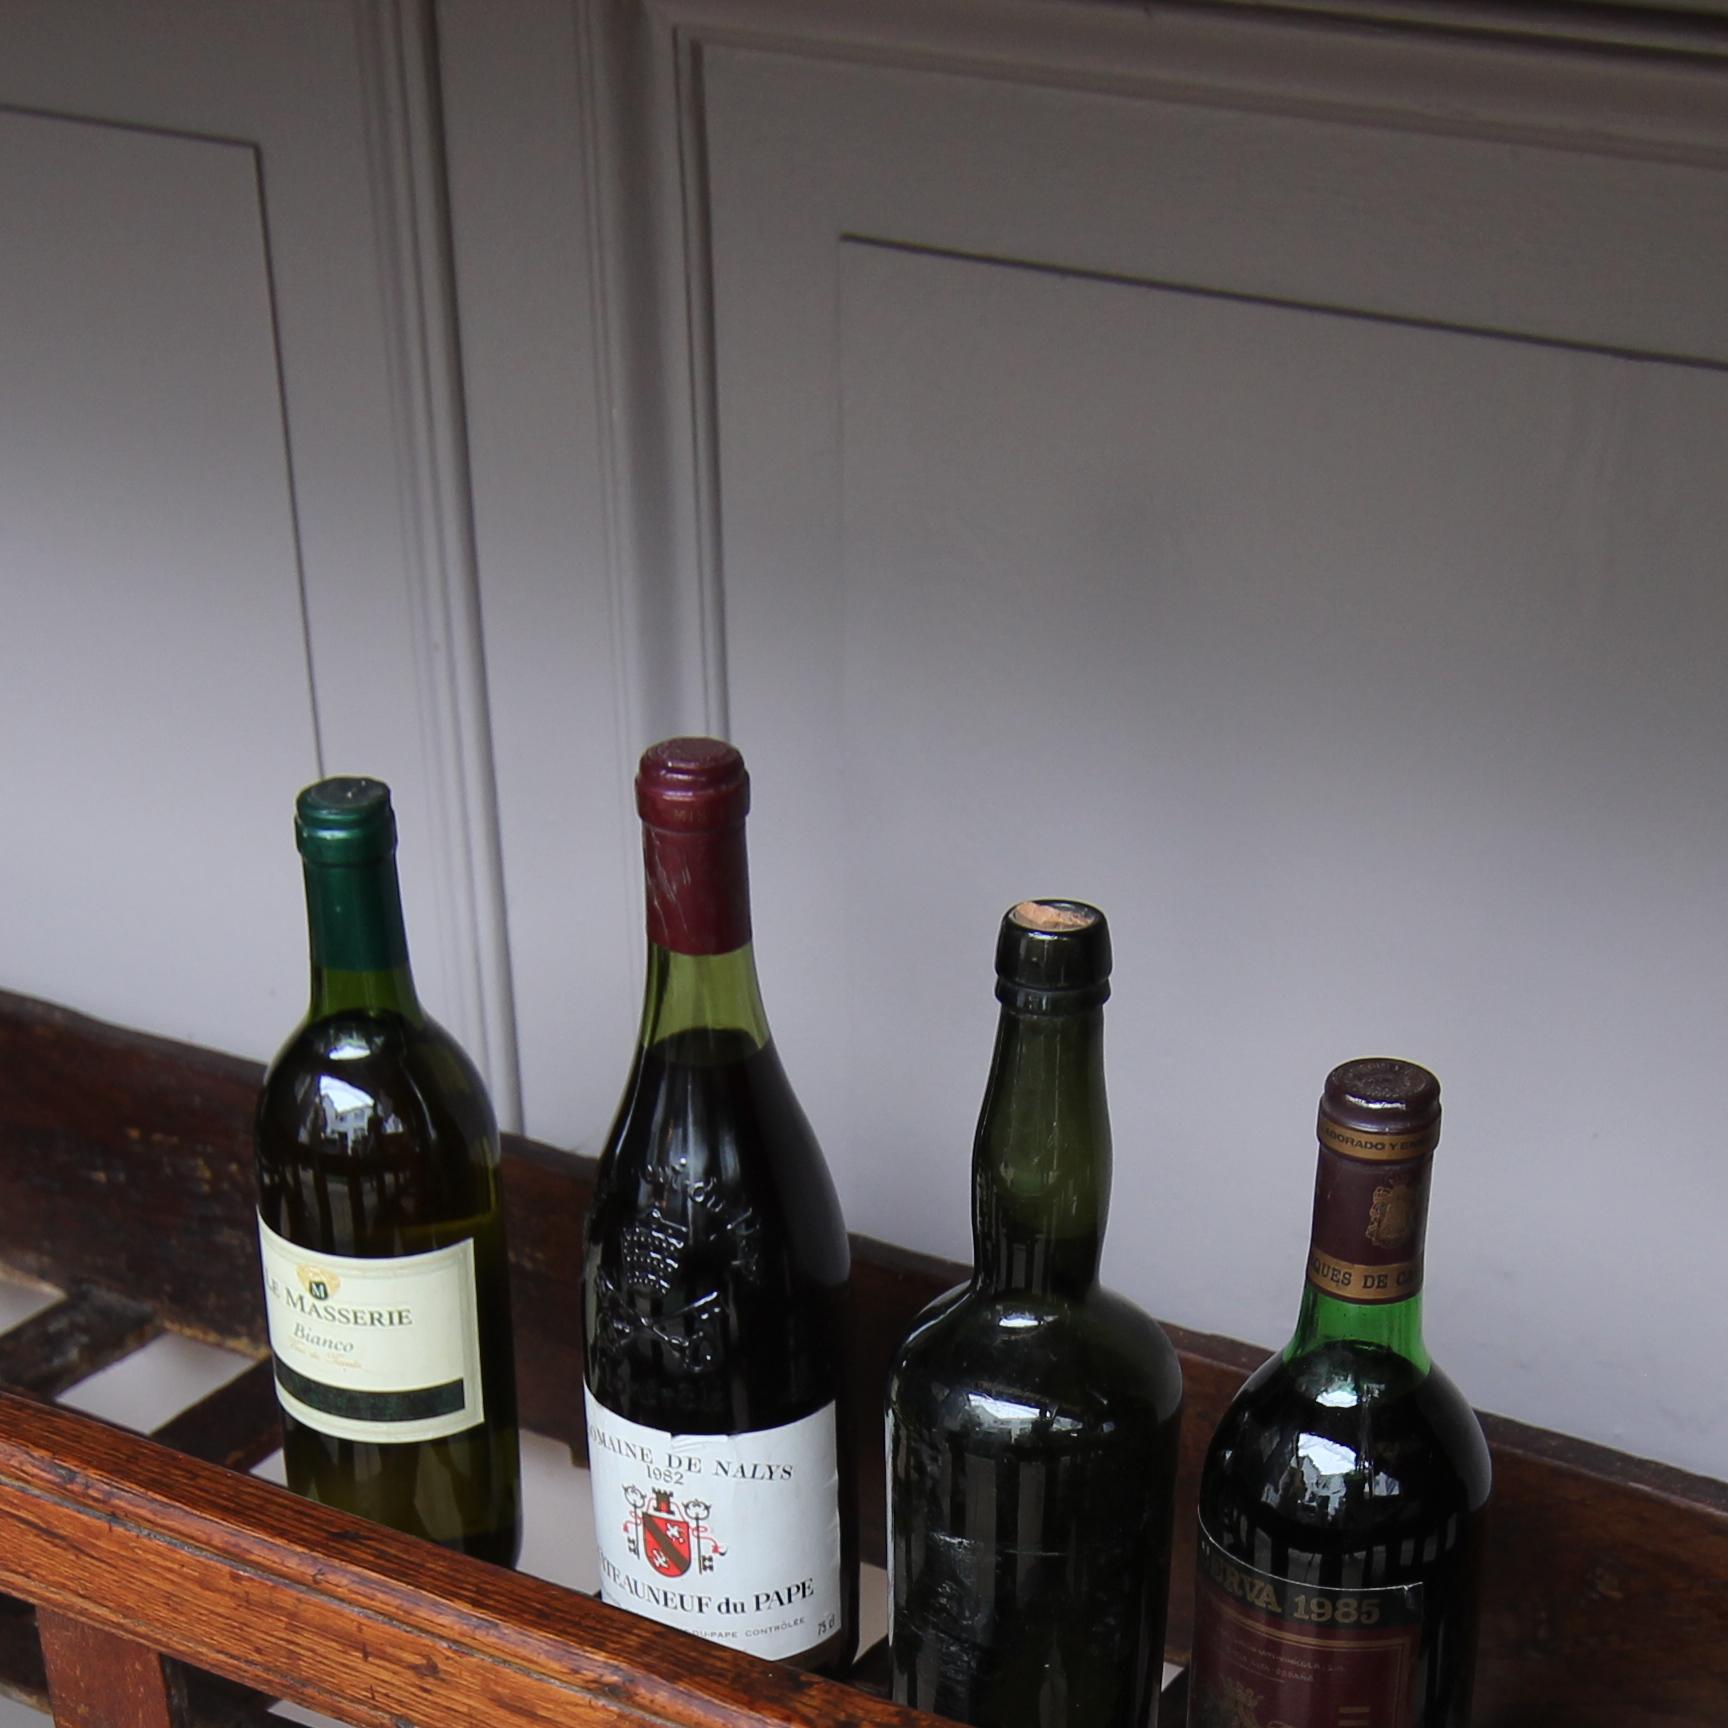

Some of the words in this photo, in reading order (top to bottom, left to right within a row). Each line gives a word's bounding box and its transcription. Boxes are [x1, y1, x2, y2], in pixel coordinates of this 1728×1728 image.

[1362, 1274, 1388, 1288] DE
[285, 1287, 413, 1326] MASSERIE
[294, 1323, 354, 1353] Bianco
[646, 1465, 684, 1485] 1982
[667, 1454, 702, 1473] DE
[714, 1460, 793, 1481] NALYS
[717, 1597, 746, 1614] du
[754, 1578, 814, 1611] PAPE
[1294, 1594, 1381, 1625] 1985
[818, 1620, 827, 1636] 75
